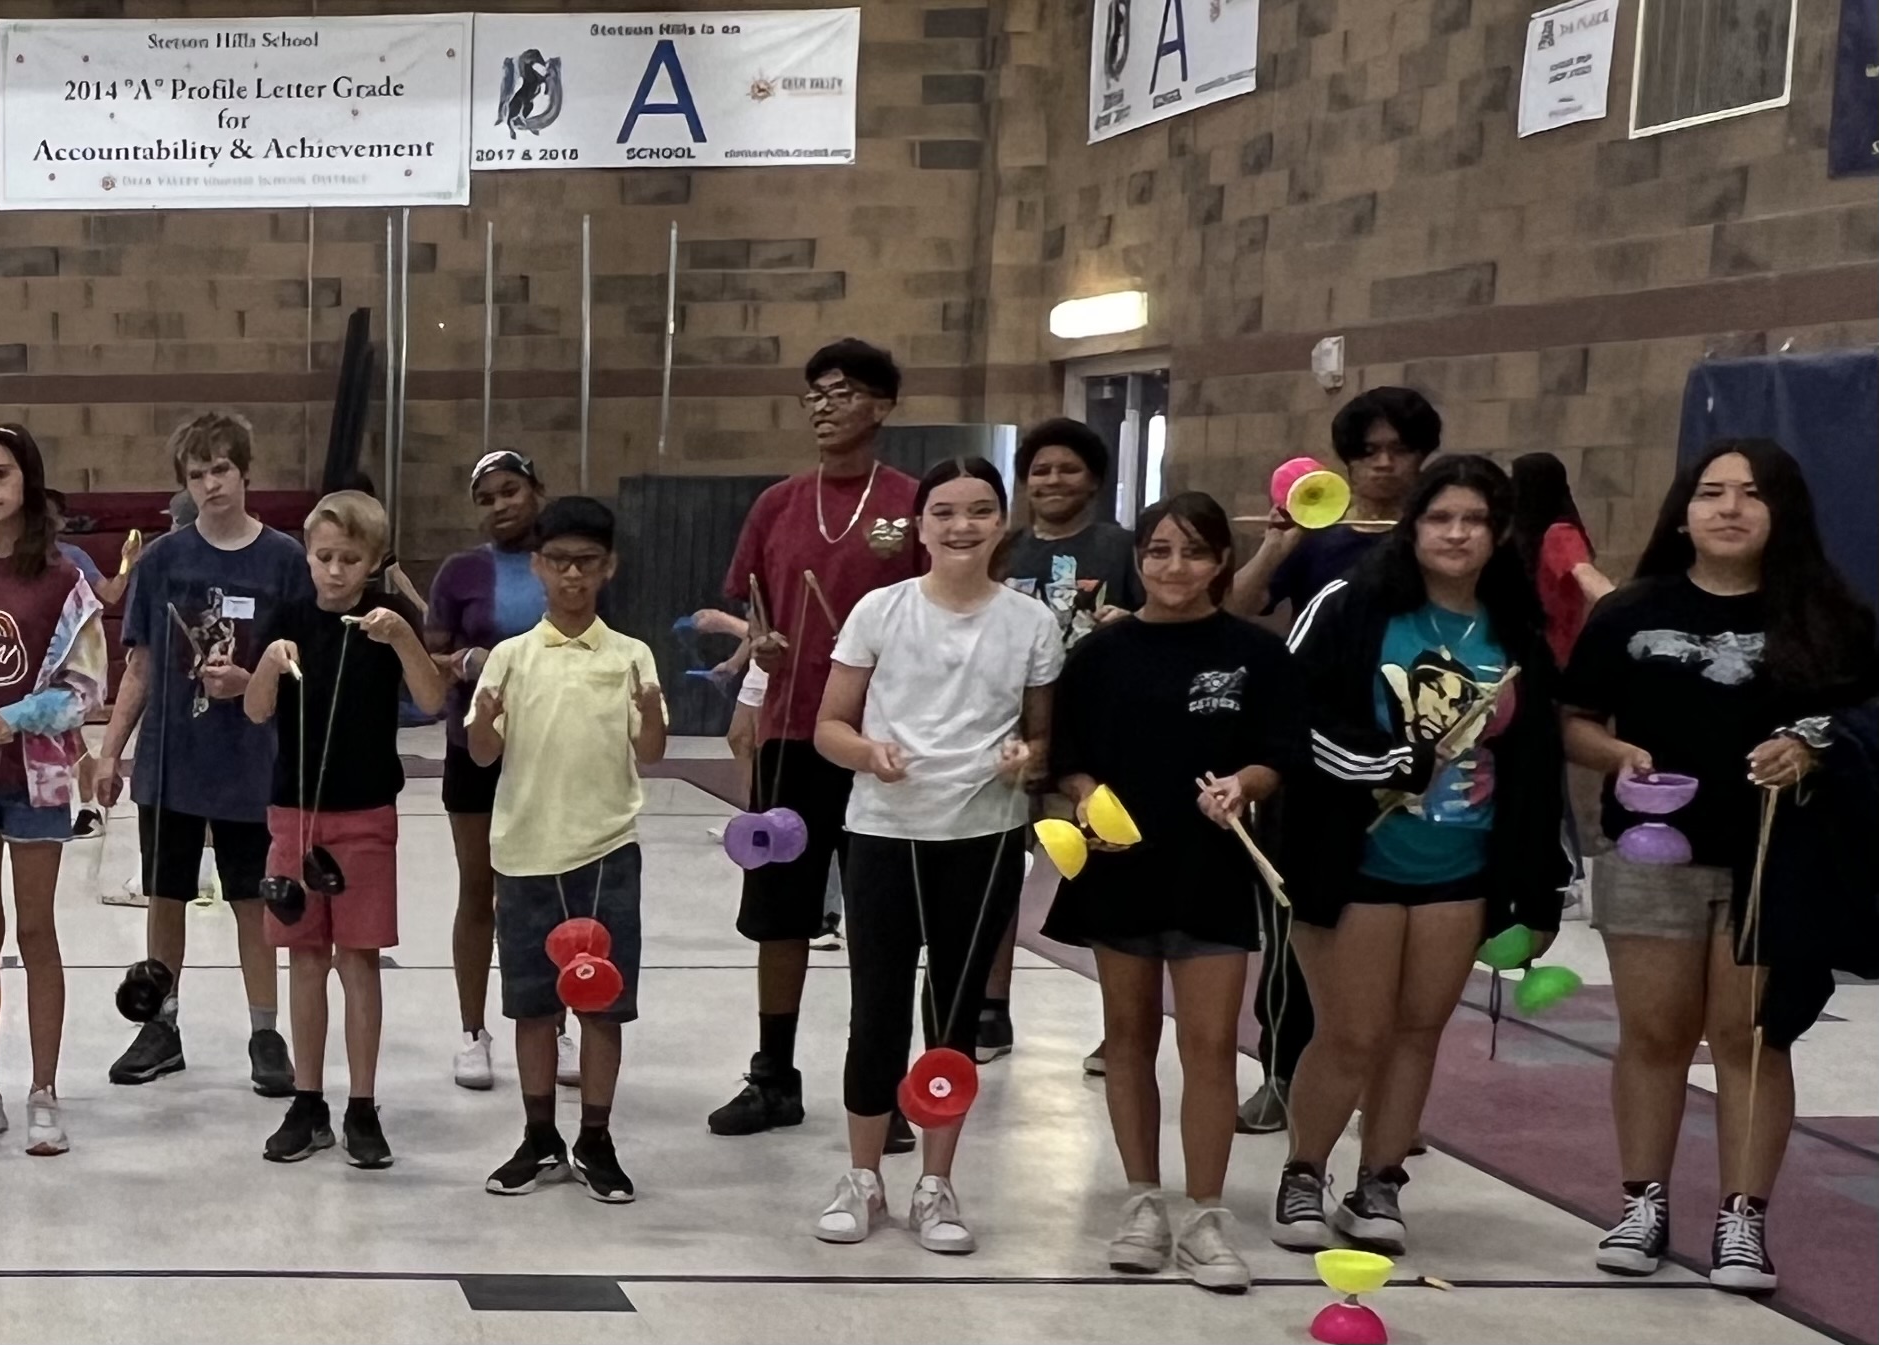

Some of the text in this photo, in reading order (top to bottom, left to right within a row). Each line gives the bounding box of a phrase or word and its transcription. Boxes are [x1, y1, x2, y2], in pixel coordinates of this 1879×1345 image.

[148, 33, 209, 50] Stetson
[261, 31, 319, 48] School
[64, 79, 118, 101] 2014
[171, 77, 248, 101] Profile
[254, 77, 327, 100] Letter
[332, 75, 405, 99] Grade
[616, 39, 708, 145] A
[218, 107, 251, 131] for
[33, 138, 436, 168] Accountability & Achievement
[625, 146, 697, 161] SCHOOL
